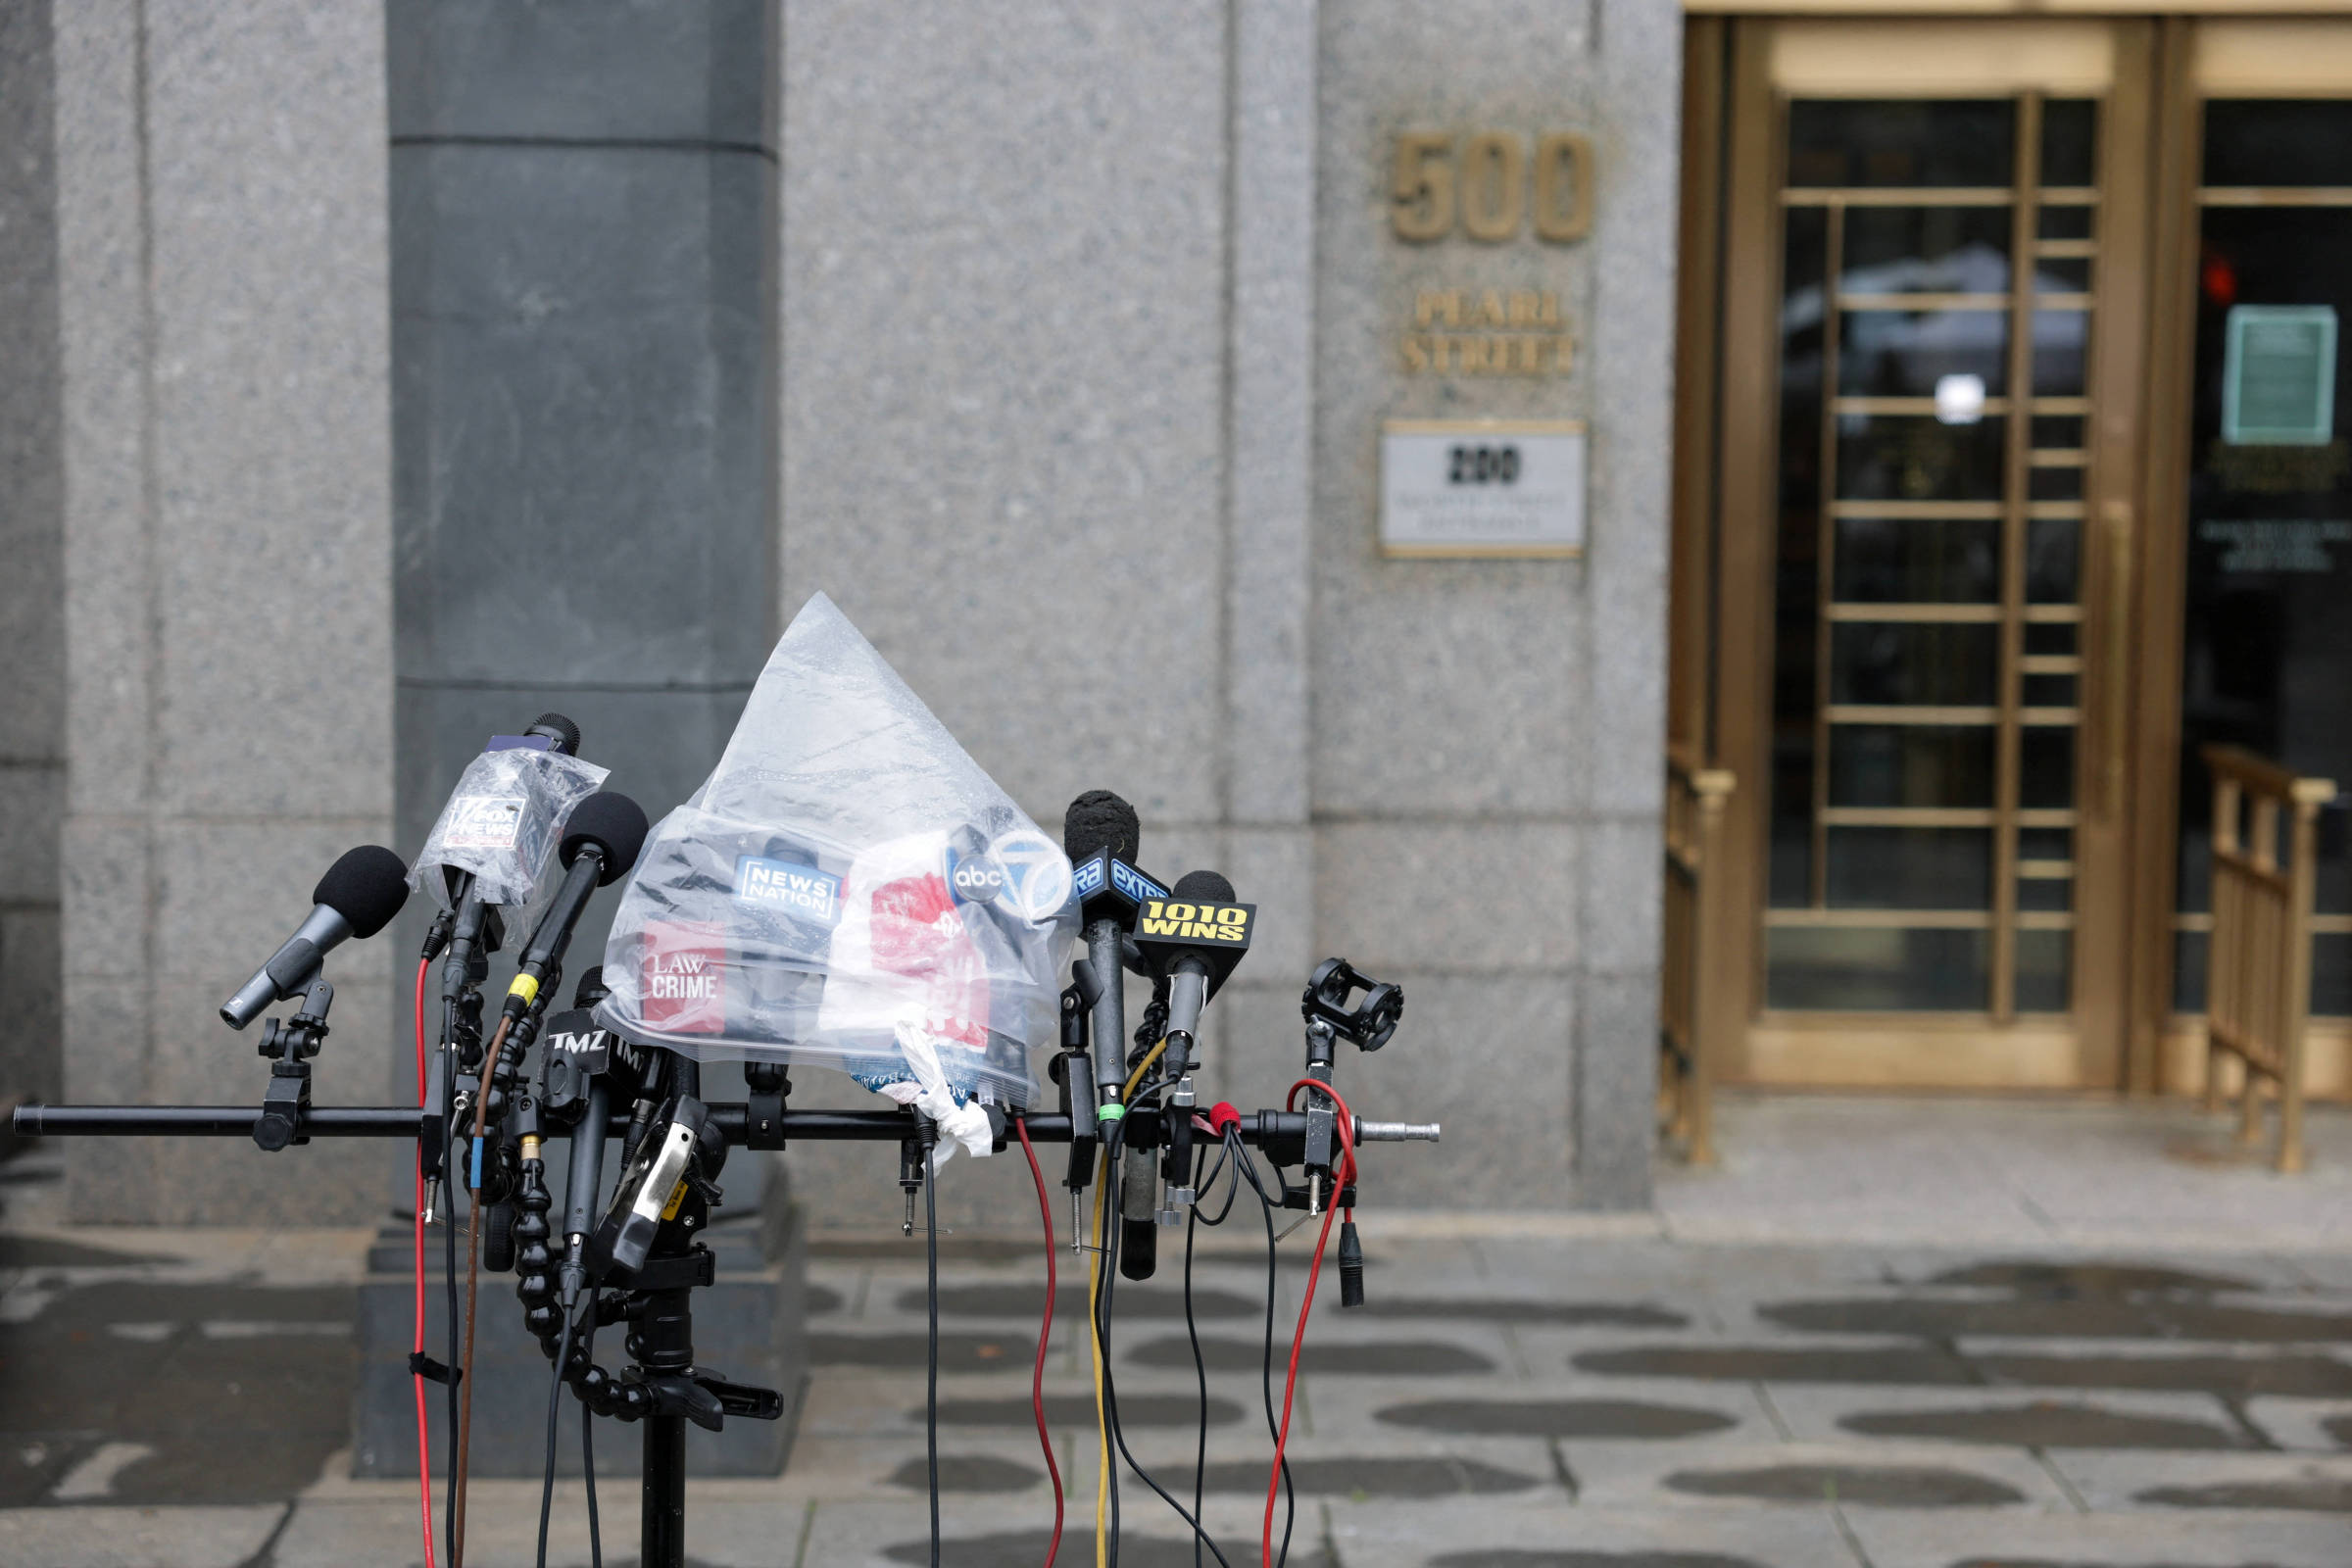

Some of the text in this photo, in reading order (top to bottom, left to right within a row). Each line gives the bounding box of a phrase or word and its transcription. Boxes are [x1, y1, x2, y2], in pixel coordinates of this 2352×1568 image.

[1392, 132, 1594, 243] 500
[1447, 444, 1522, 486] 200
[473, 809, 515, 823] FOX
[459, 823, 514, 836] NEWS
[751, 867, 828, 898] NEWS
[956, 864, 1003, 887] abc
[749, 884, 826, 913] NATION
[1148, 901, 1248, 926] 1010
[1142, 917, 1246, 942] WINS
[654, 954, 706, 974] LAW
[652, 975, 717, 999] CRIME
[549, 1029, 608, 1054] TMZ
[616, 1036, 645, 1074] TM
